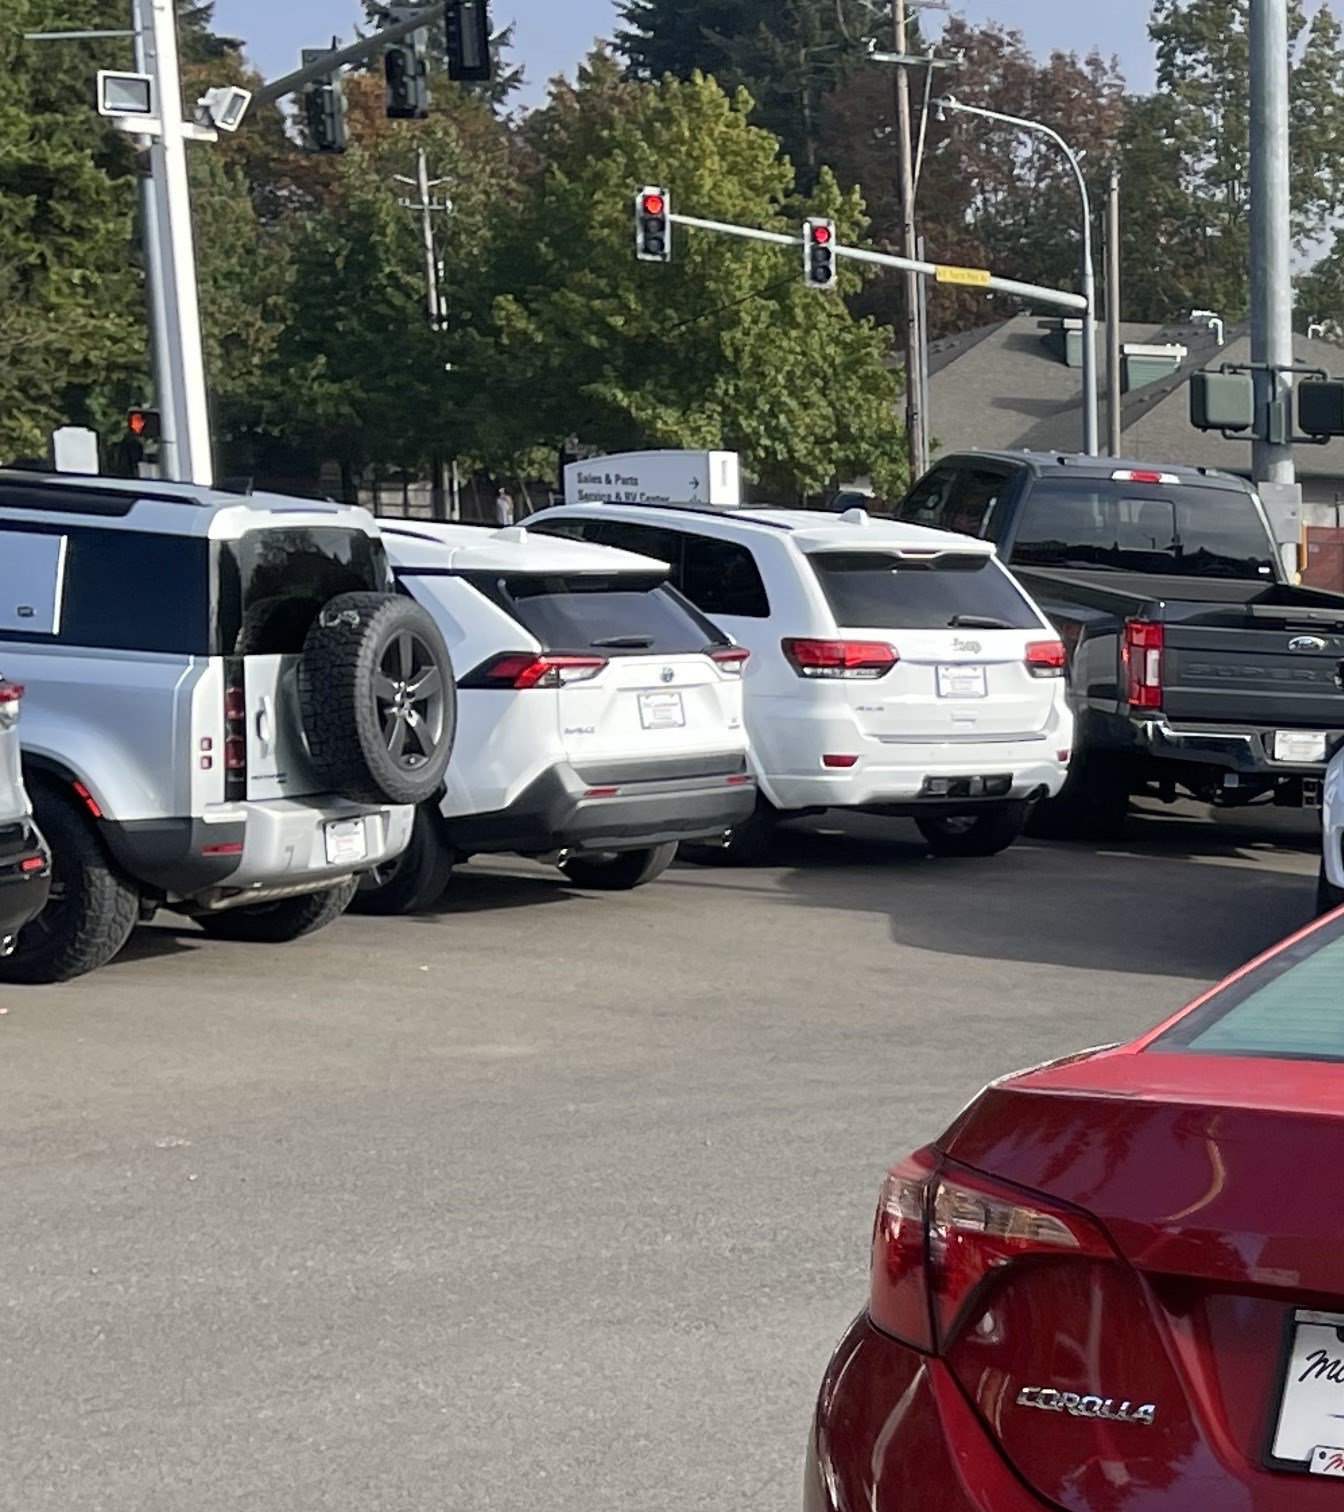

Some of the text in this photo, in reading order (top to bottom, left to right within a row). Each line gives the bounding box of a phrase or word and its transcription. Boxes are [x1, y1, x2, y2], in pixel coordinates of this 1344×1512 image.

[576, 472, 603, 485] Sales
[614, 474, 639, 487] Parts
[1016, 1386, 1156, 1425] COROLLA
